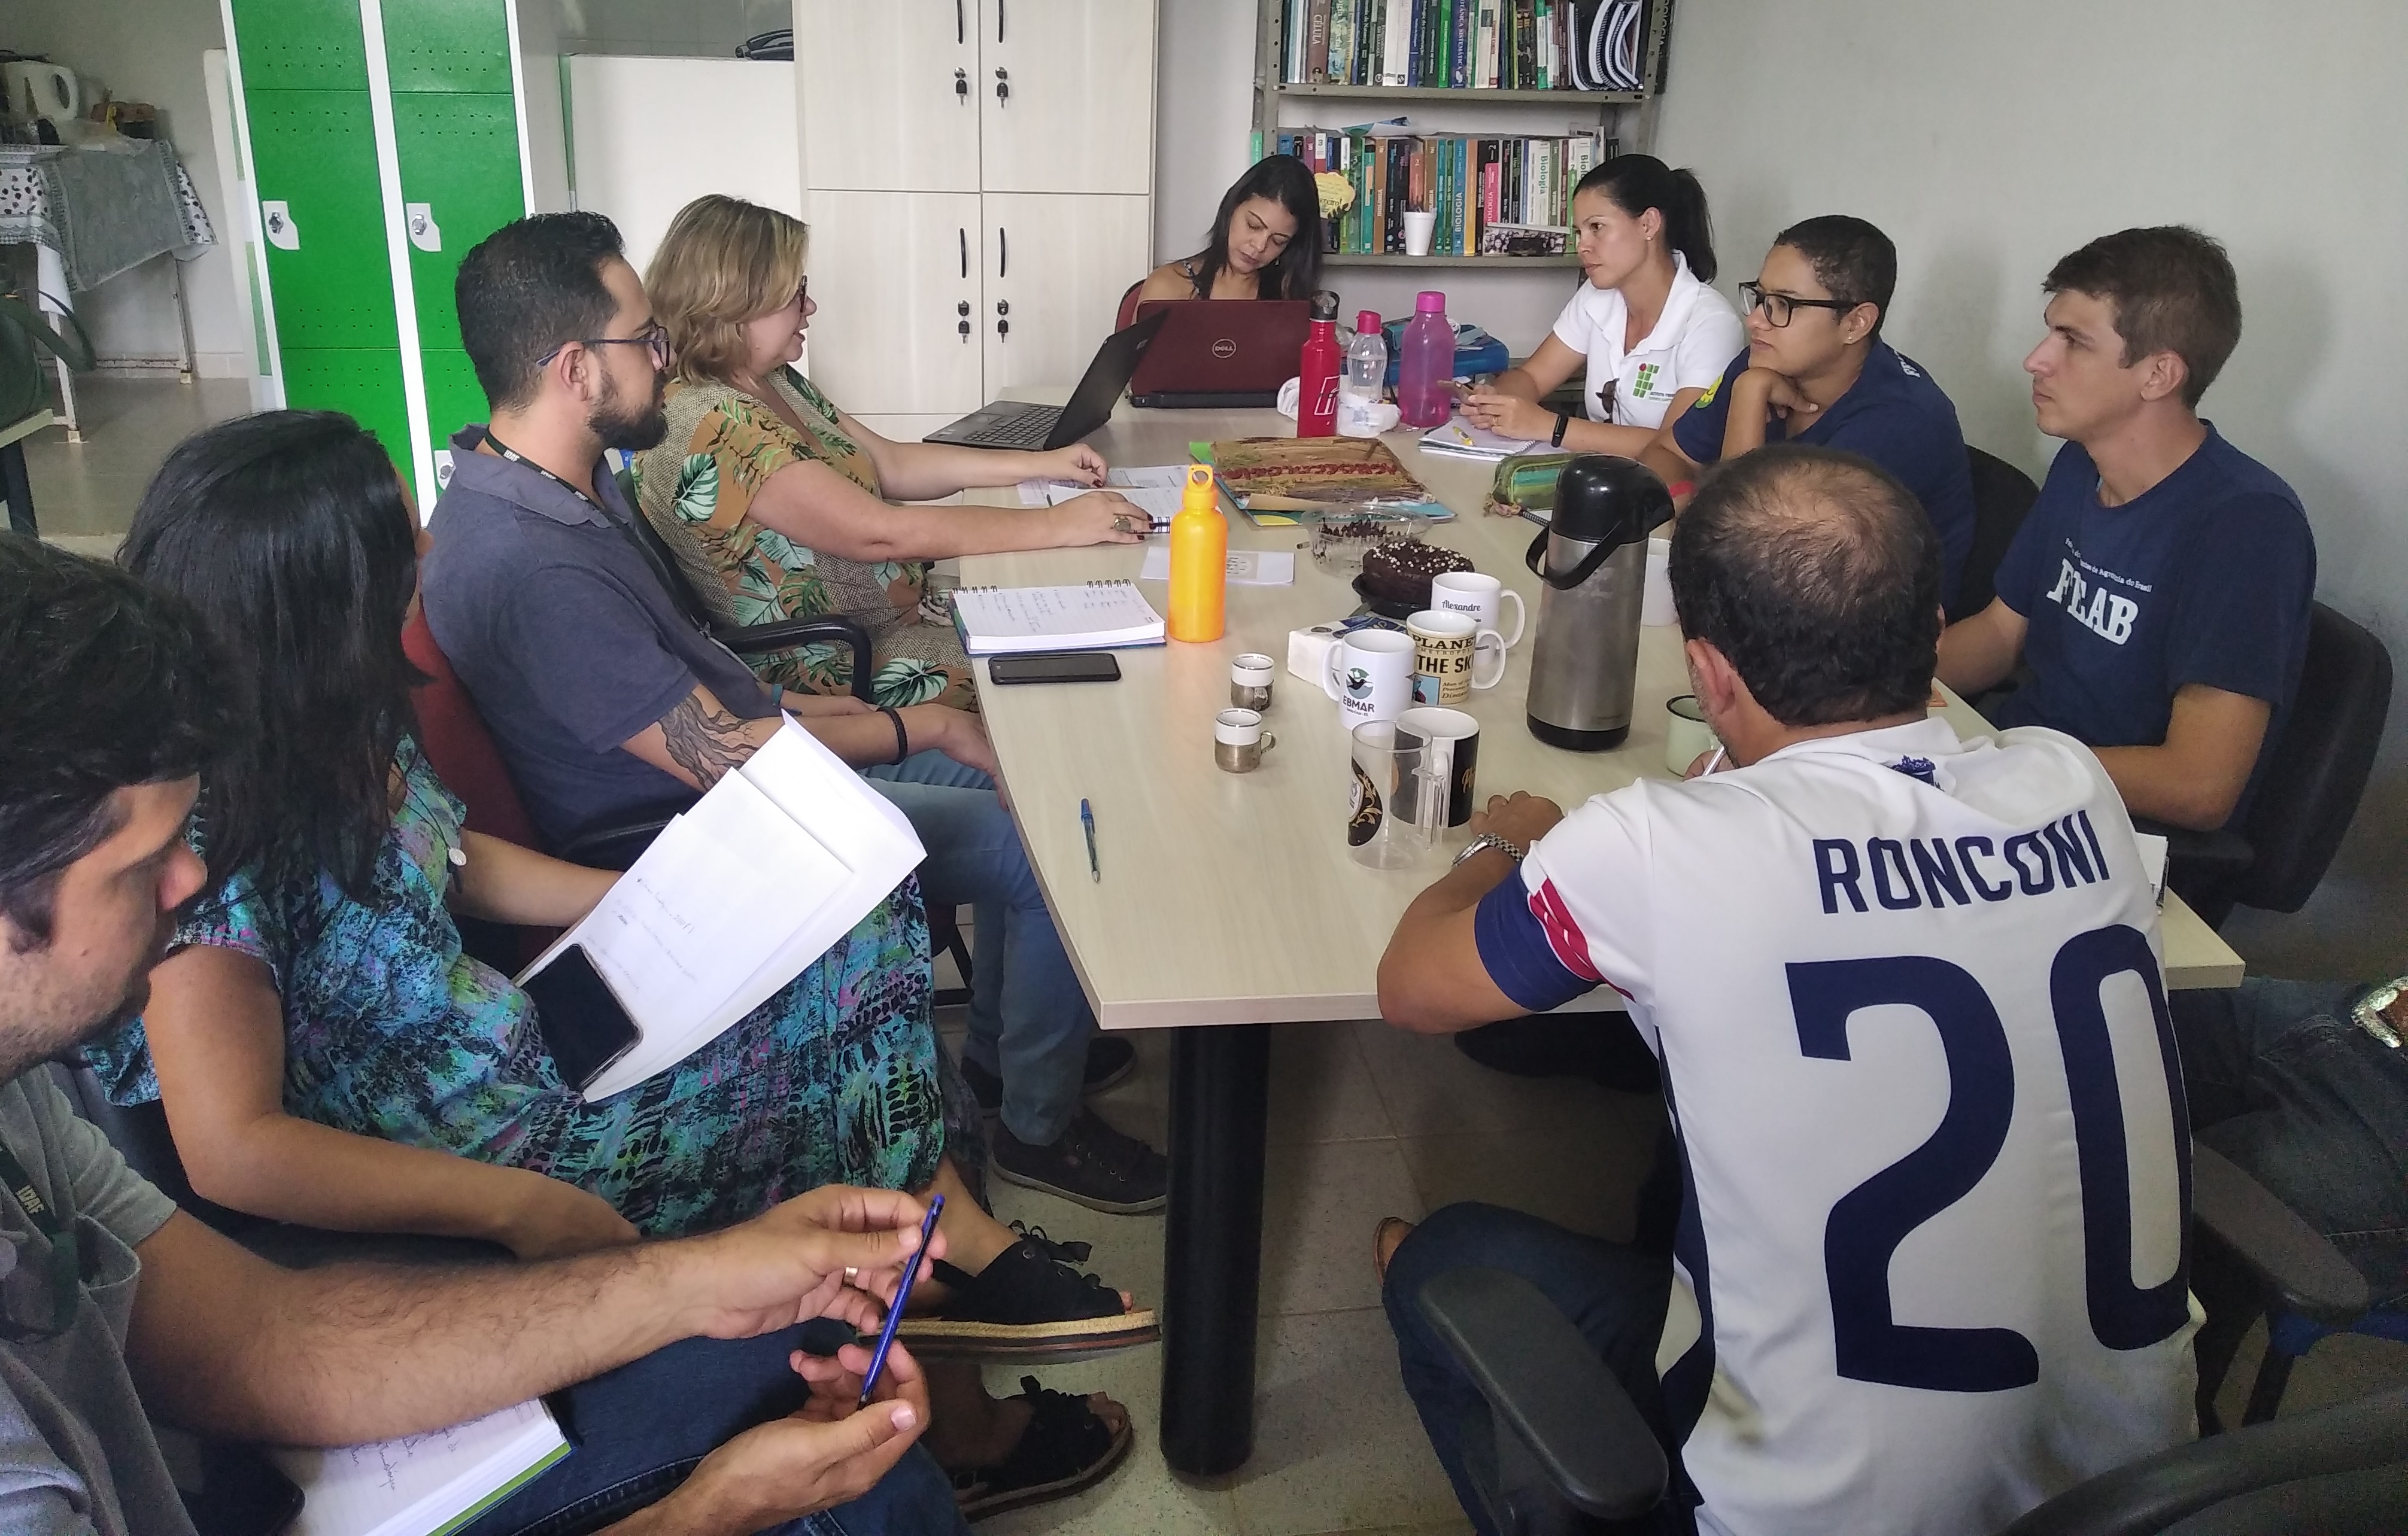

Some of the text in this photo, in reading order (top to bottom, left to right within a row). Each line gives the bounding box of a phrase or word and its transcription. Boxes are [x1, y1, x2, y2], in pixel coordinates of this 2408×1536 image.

[1538, 155, 1548, 195] Biologia
[1441, 600, 1481, 612] Alexandre
[1411, 634, 1476, 650] PLANE
[1417, 655, 1450, 674] THE
[1343, 695, 1375, 713] EBMAR
[1812, 809, 2111, 915] RONCONI
[1785, 924, 2192, 1393] 20
[15, 1185, 45, 1213] IDAF
